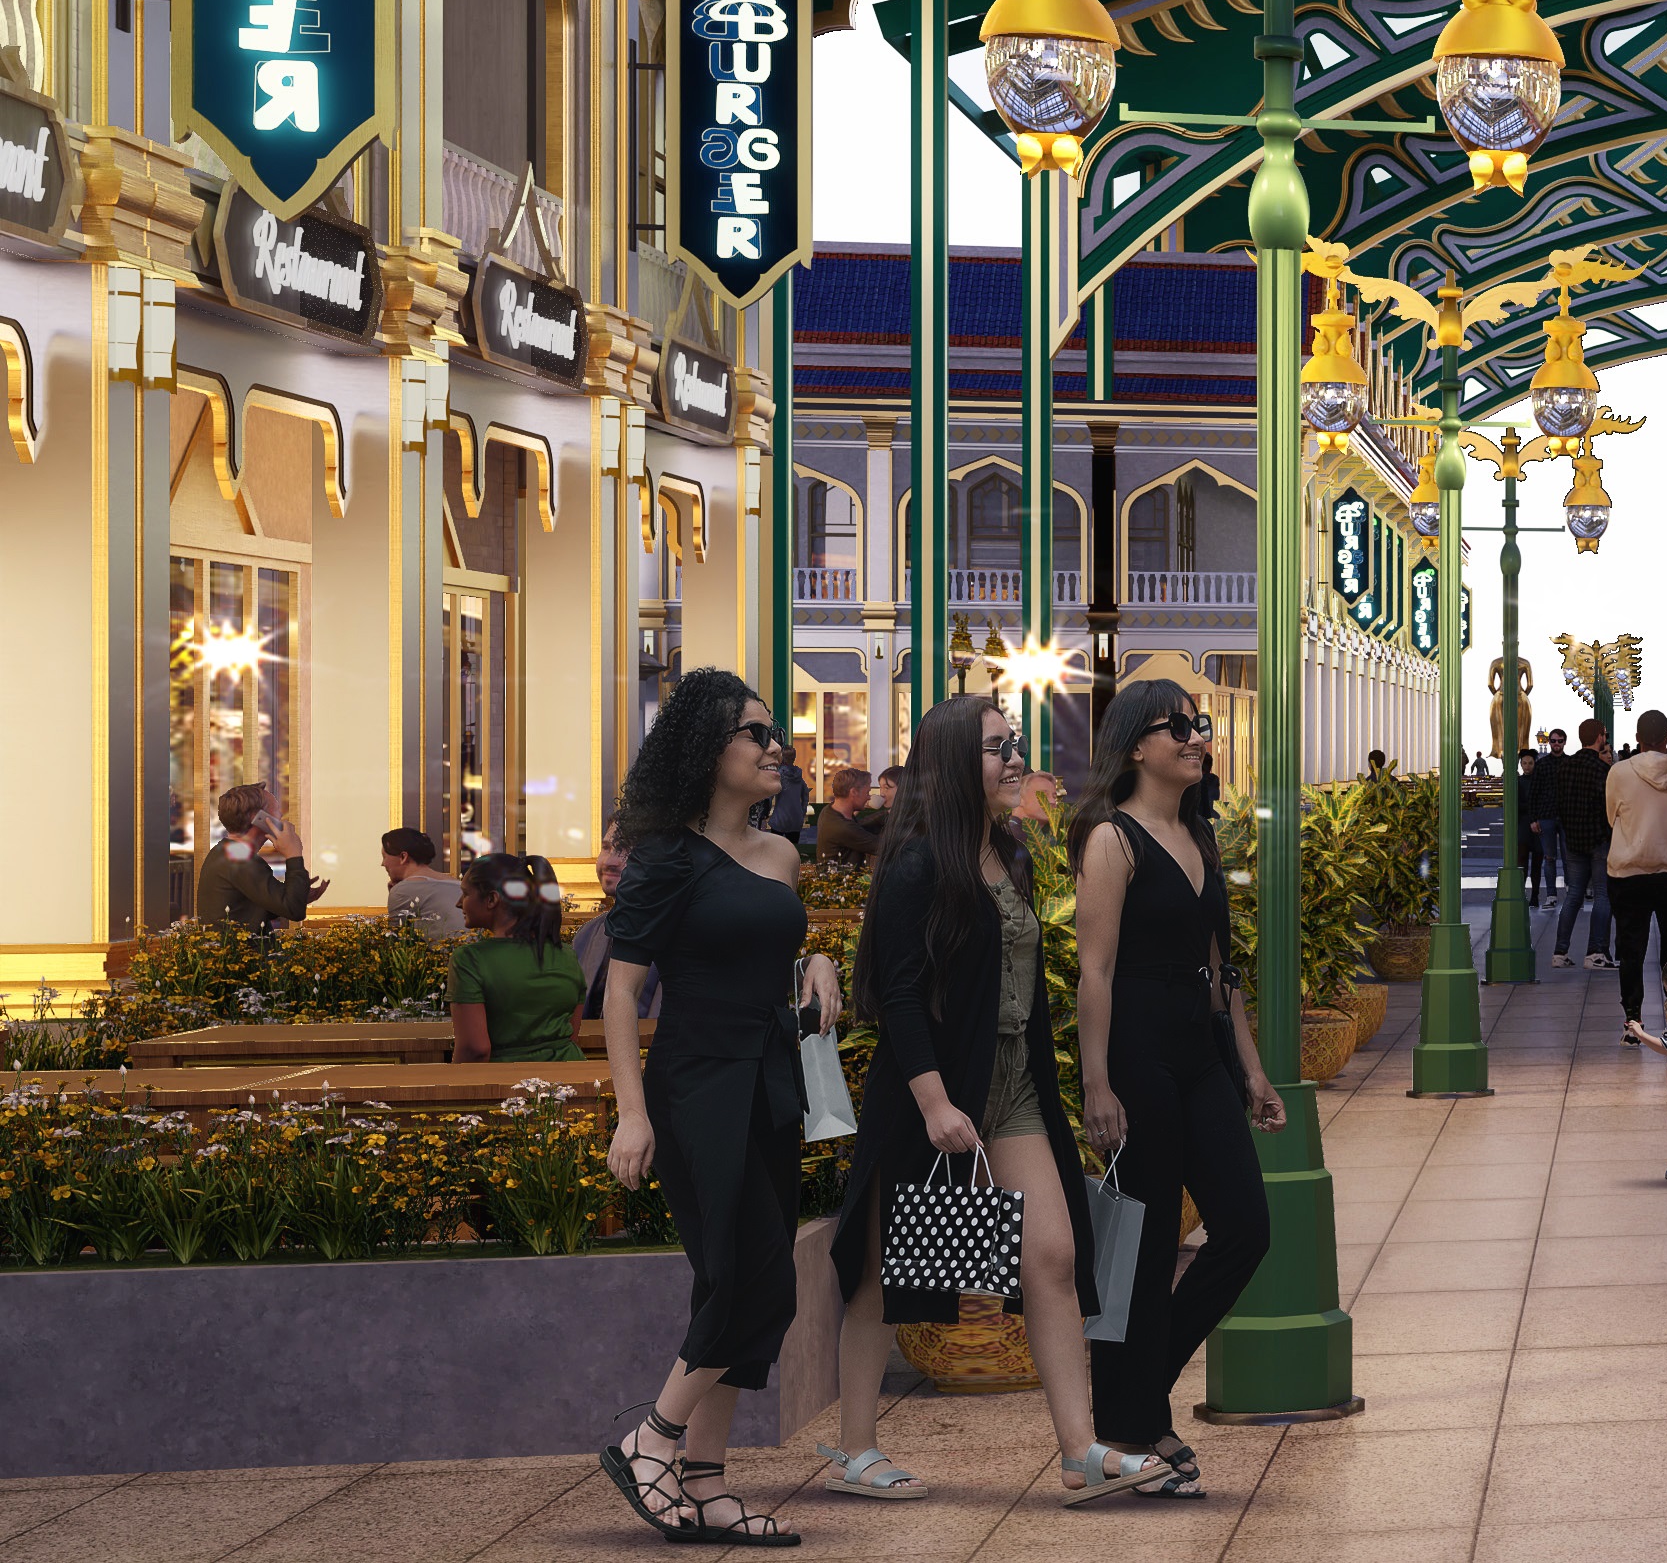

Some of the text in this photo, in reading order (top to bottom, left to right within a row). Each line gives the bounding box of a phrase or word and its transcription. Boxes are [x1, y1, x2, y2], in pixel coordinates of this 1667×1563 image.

[253, 212, 366, 312] Restaurant
[500, 279, 578, 361] Restaurant
[674, 351, 728, 418] Restaurant
